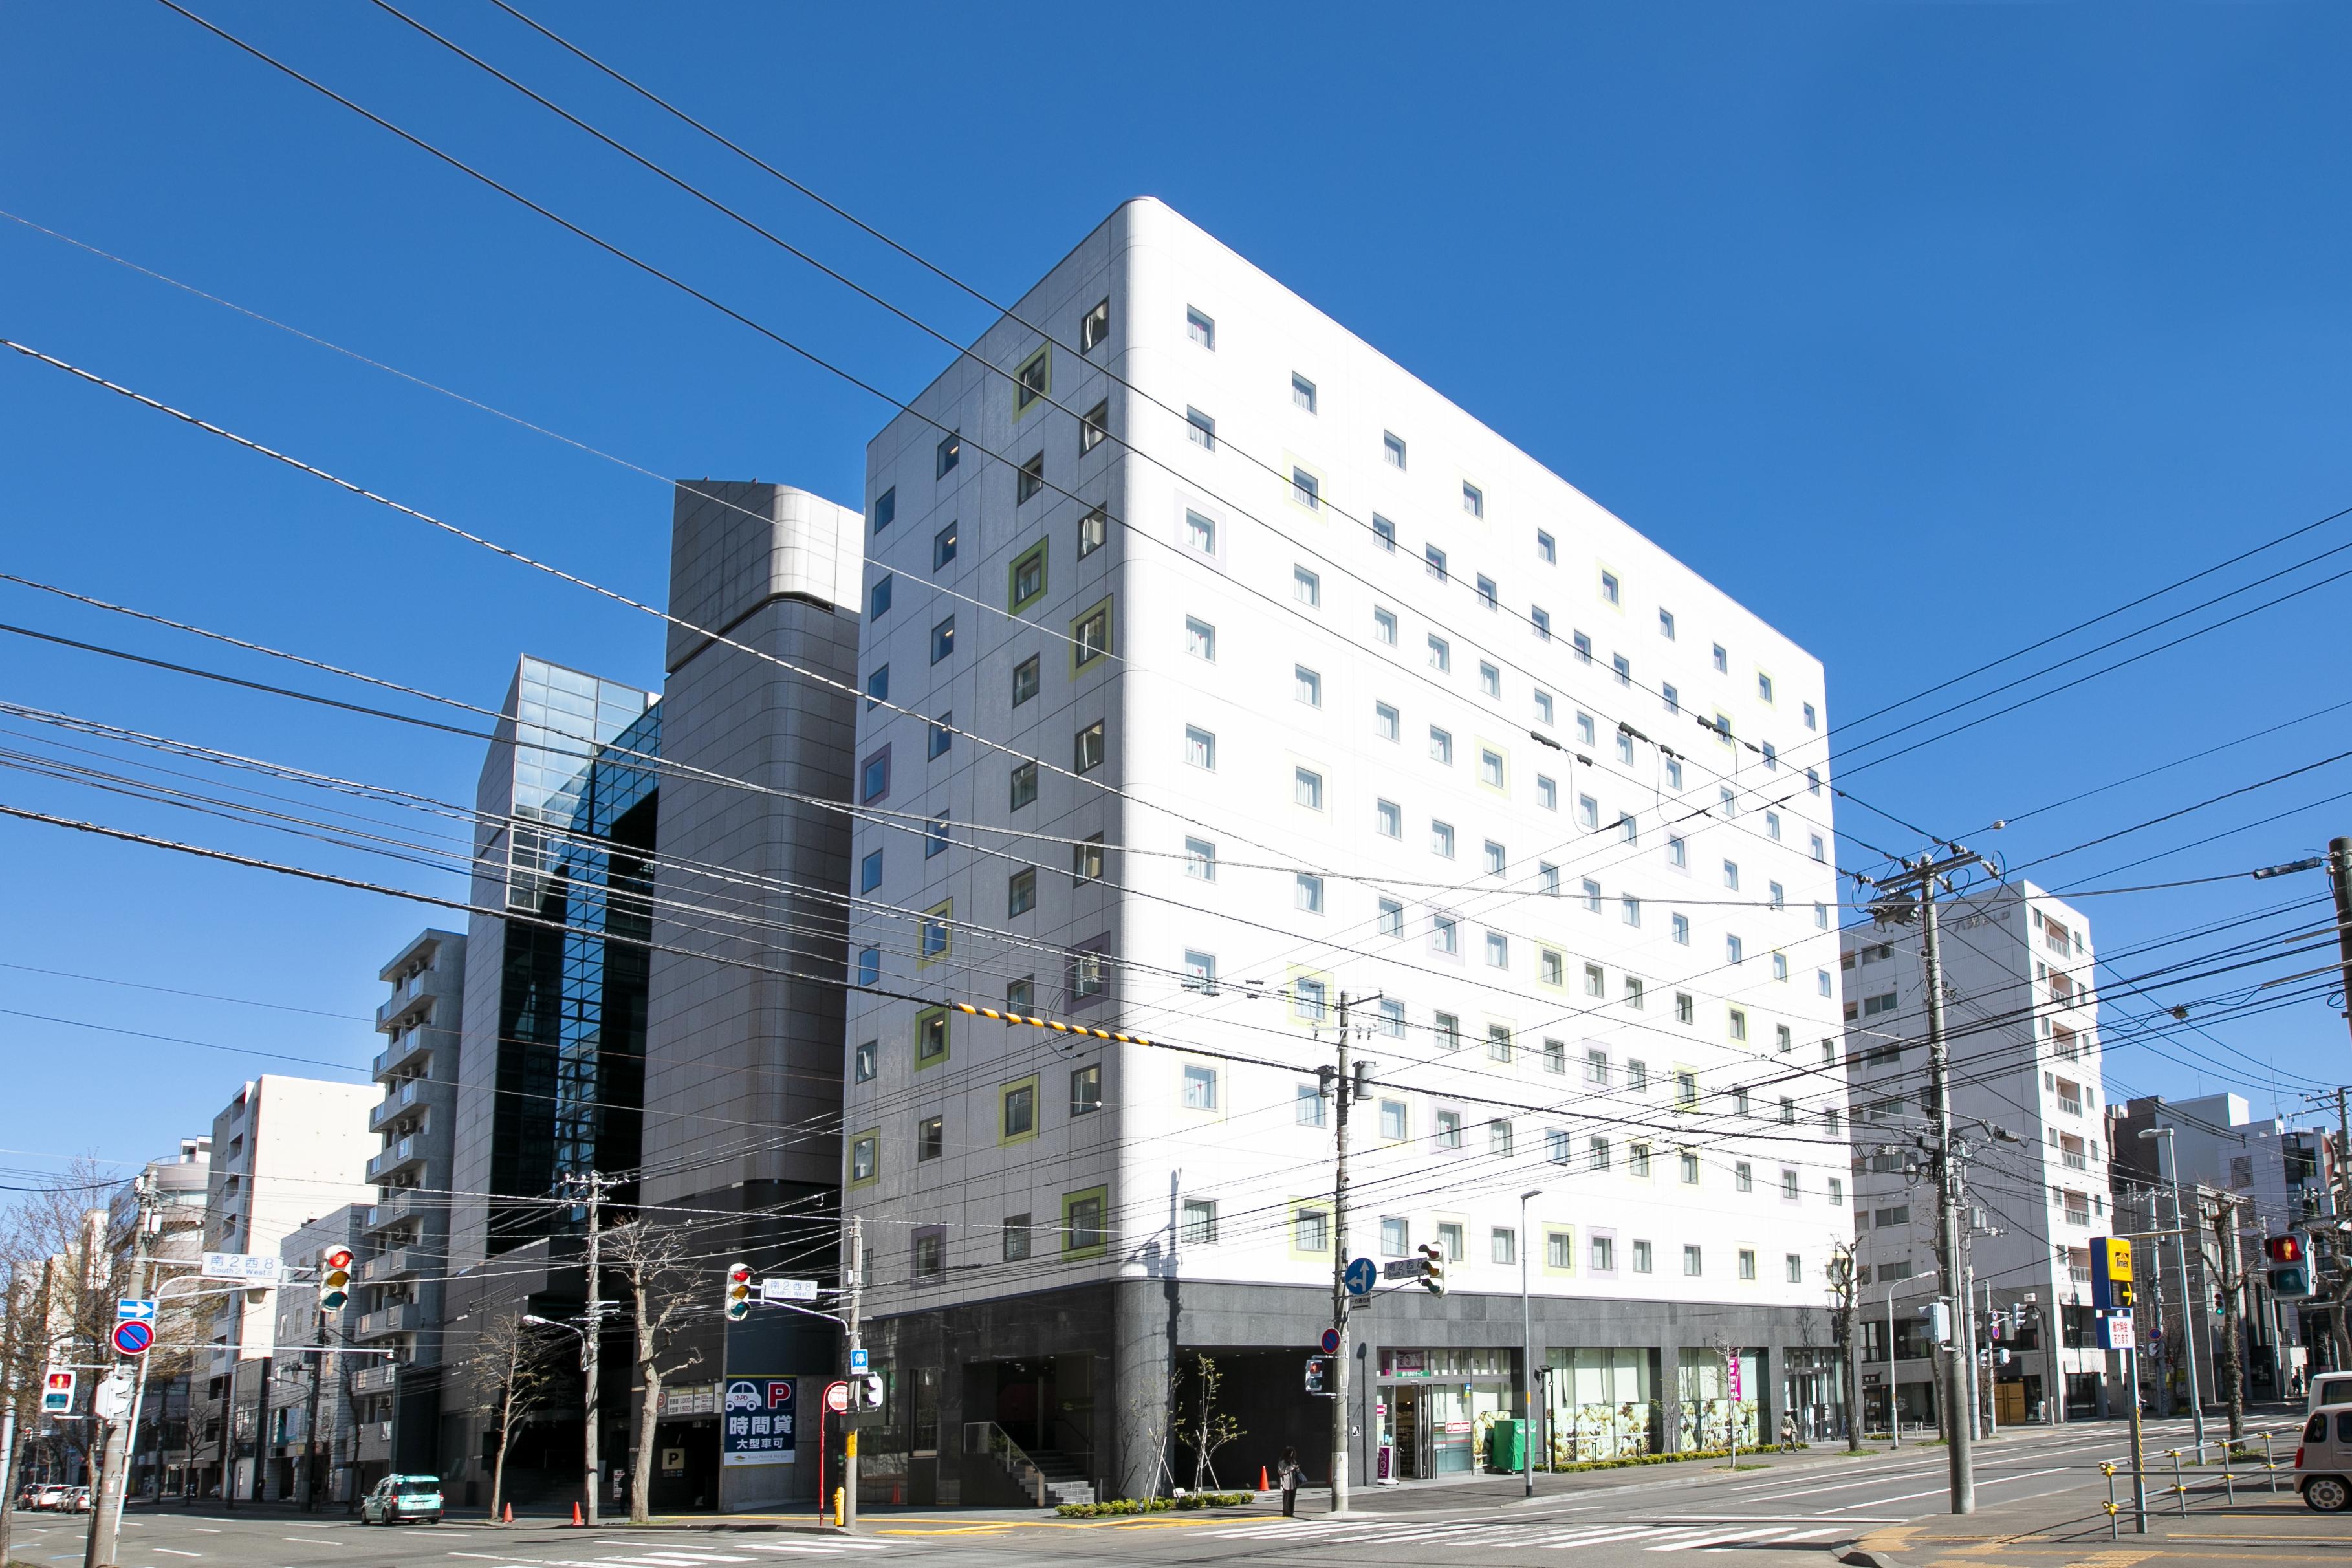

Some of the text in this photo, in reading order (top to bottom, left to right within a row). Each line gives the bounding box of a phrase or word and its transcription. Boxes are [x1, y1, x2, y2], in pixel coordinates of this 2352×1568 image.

[210, 1255, 274, 1269] 南2西8
[2116, 1256, 2129, 1268] Times
[770, 1281, 811, 1291] 南2西8
[2113, 1321, 2128, 1333] 最大料金
[2114, 1334, 2128, 1344] あります
[854, 1353, 866, 1364] 停
[1397, 1353, 1421, 1367] EON
[768, 1382, 792, 1409] P
[729, 1415, 792, 1435] 時間貸
[737, 1437, 784, 1450] 大型車可
[668, 1452, 679, 1465] P
